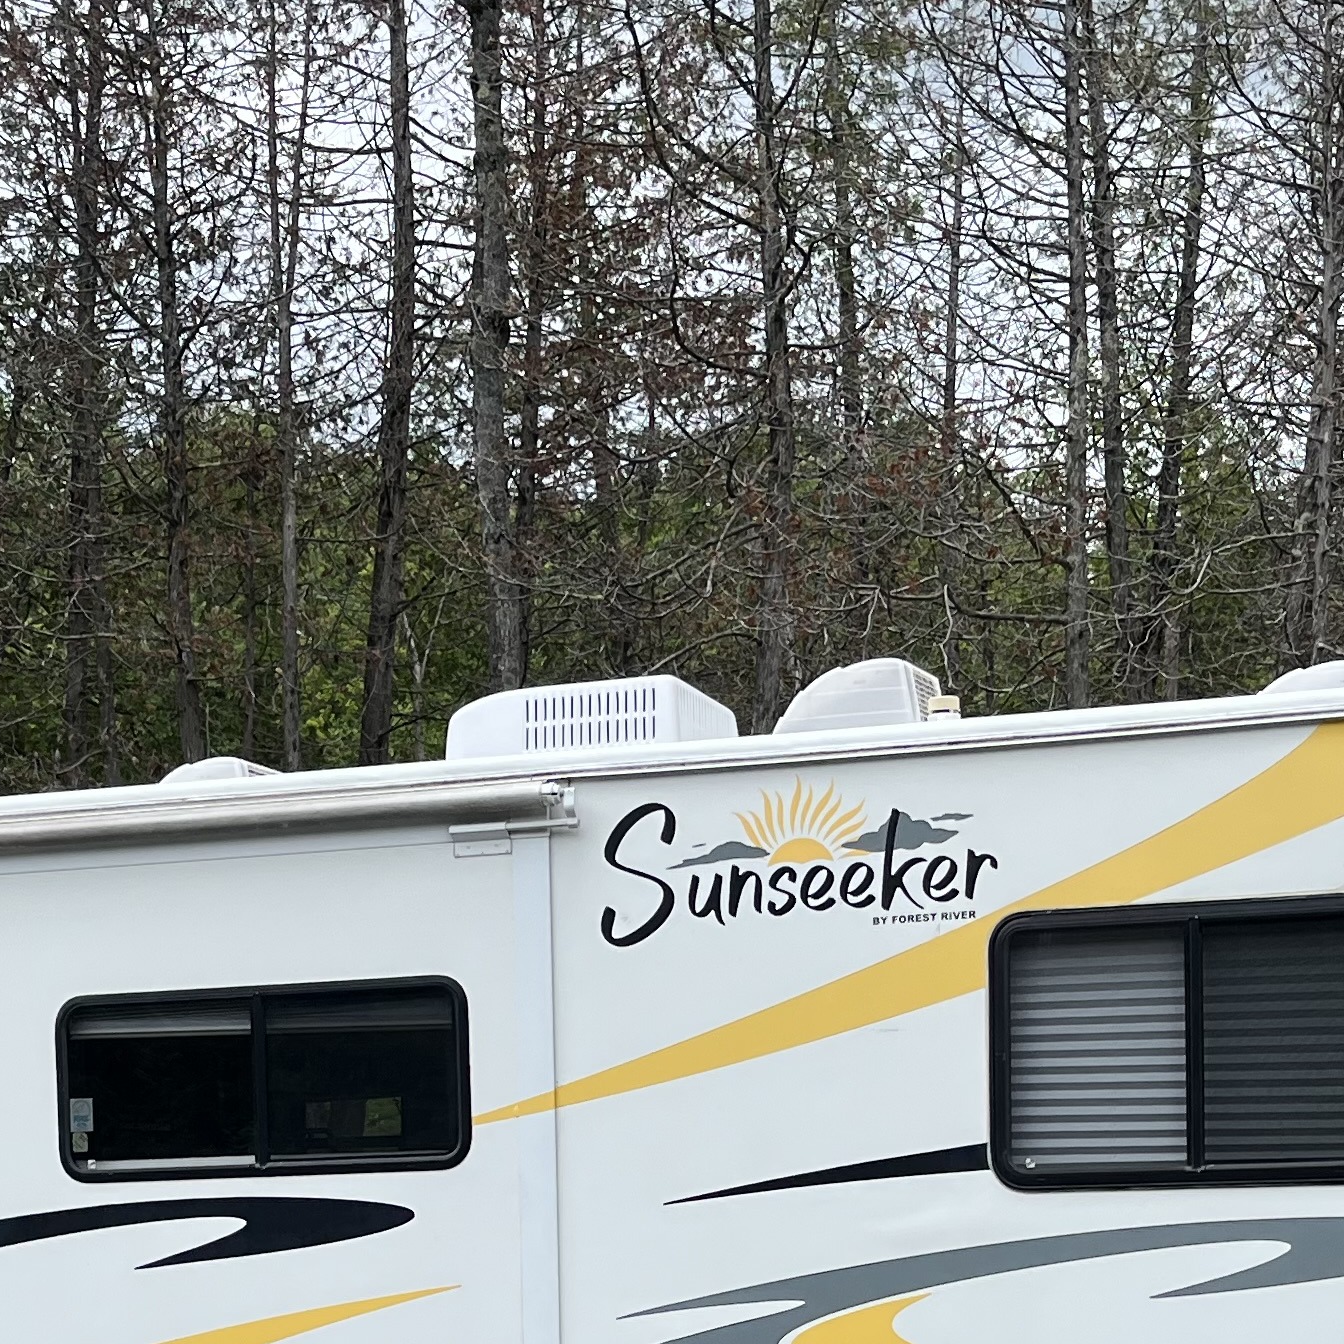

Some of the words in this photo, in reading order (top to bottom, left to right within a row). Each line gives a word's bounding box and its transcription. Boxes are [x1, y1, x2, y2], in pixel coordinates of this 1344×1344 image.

[600, 802, 998, 947] Sunseeker
[872, 916, 888, 925] BY
[892, 913, 937, 924] FOREST
[941, 910, 976, 920] RIVER
